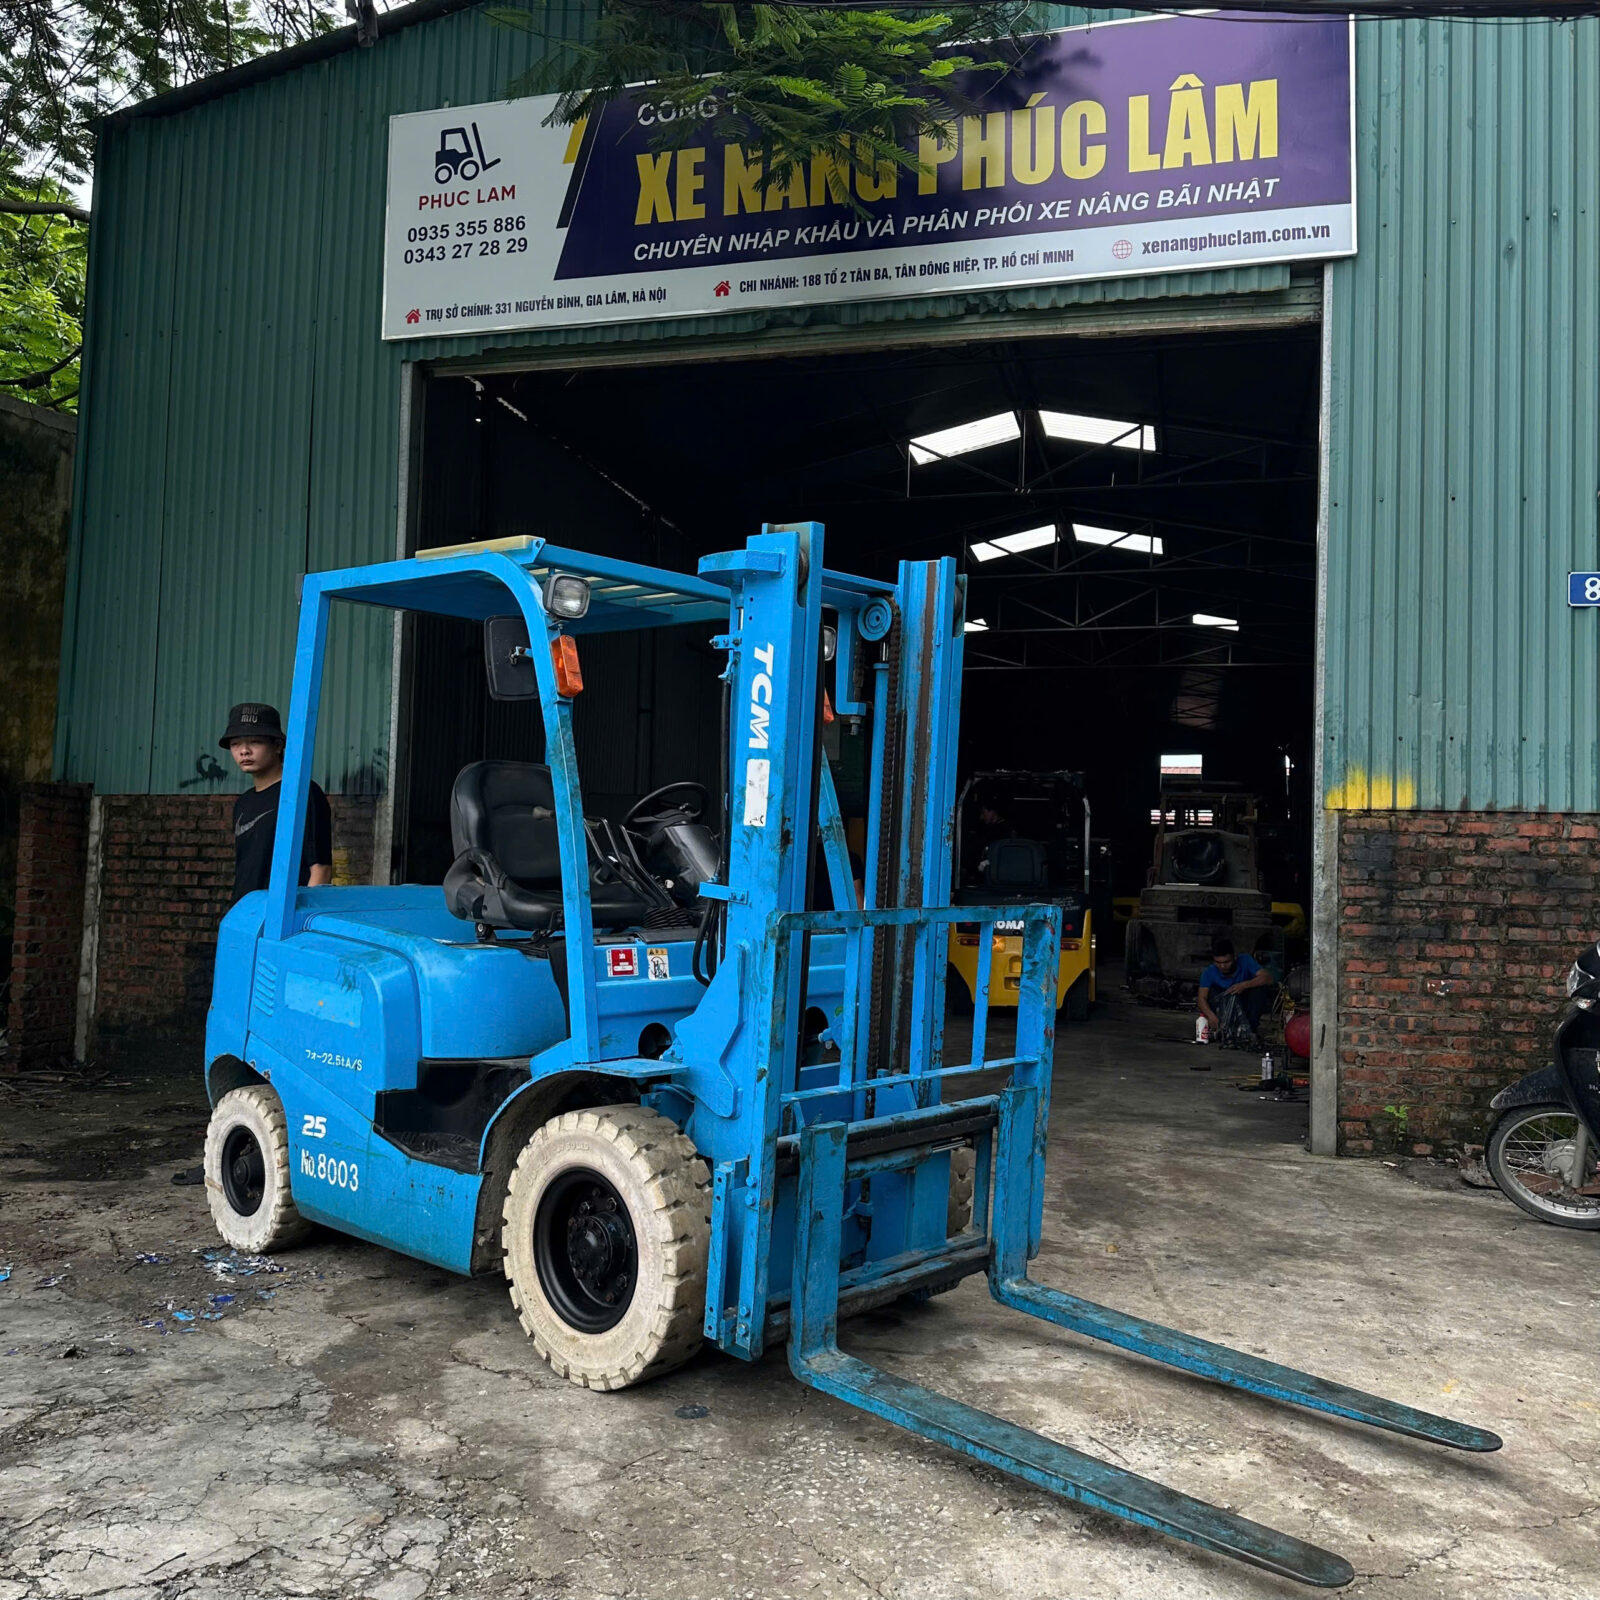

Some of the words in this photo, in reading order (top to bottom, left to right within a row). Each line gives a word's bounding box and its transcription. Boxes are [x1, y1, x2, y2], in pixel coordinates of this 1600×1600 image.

[634, 147, 706, 225] XE
[918, 91, 1106, 196] PHÚC
[1128, 73, 1278, 173] LÂM
[418, 190, 470, 211] PHUC
[477, 184, 516, 204] LAM
[407, 223, 450, 243] 0935
[455, 219, 488, 238] 355
[493, 215, 526, 234] 886
[634, 233, 722, 261] CHUYÊN
[728, 228, 790, 254] NHẬP
[866, 214, 895, 237] VÀ
[902, 207, 968, 235] PHÂN
[974, 199, 1032, 227] PHỐI
[1037, 201, 1071, 220] XE
[1077, 191, 1150, 217] NÂNG
[1157, 183, 1202, 209] BÃI
[1207, 177, 1280, 204] NHẬT
[403, 246, 446, 265] 0343
[452, 243, 475, 259] 27
[479, 240, 500, 256] 28
[506, 236, 528, 253] 29
[1142, 224, 1330, 255] xenangphuclam.com.vn
[739, 279, 757, 293] CHI
[760, 274, 799, 291] NHÁNH:
[802, 274, 821, 287] 188
[840, 271, 847, 284] 2
[849, 267, 871, 283] TÂN
[874, 268, 892, 281] BA,
[895, 263, 916, 279] TÂN
[919, 261, 950, 276] ĐÔNG
[953, 257, 980, 274] HIỆP,
[983, 258, 998, 270] TP.
[1020, 250, 1039, 266] CHÍ
[1042, 249, 1074, 264] MINH
[425, 308, 443, 322] TRỤ
[461, 302, 493, 317] CHÍNH:
[495, 303, 512, 314] 331
[557, 294, 583, 309] BÌNH,
[586, 294, 601, 306] GIA
[605, 291, 630, 305] LÂM,
[632, 288, 646, 302] HÀ
[649, 287, 667, 303] NỘI
[748, 641, 775, 750] TCM
[302, 1114, 327, 1138] 25
